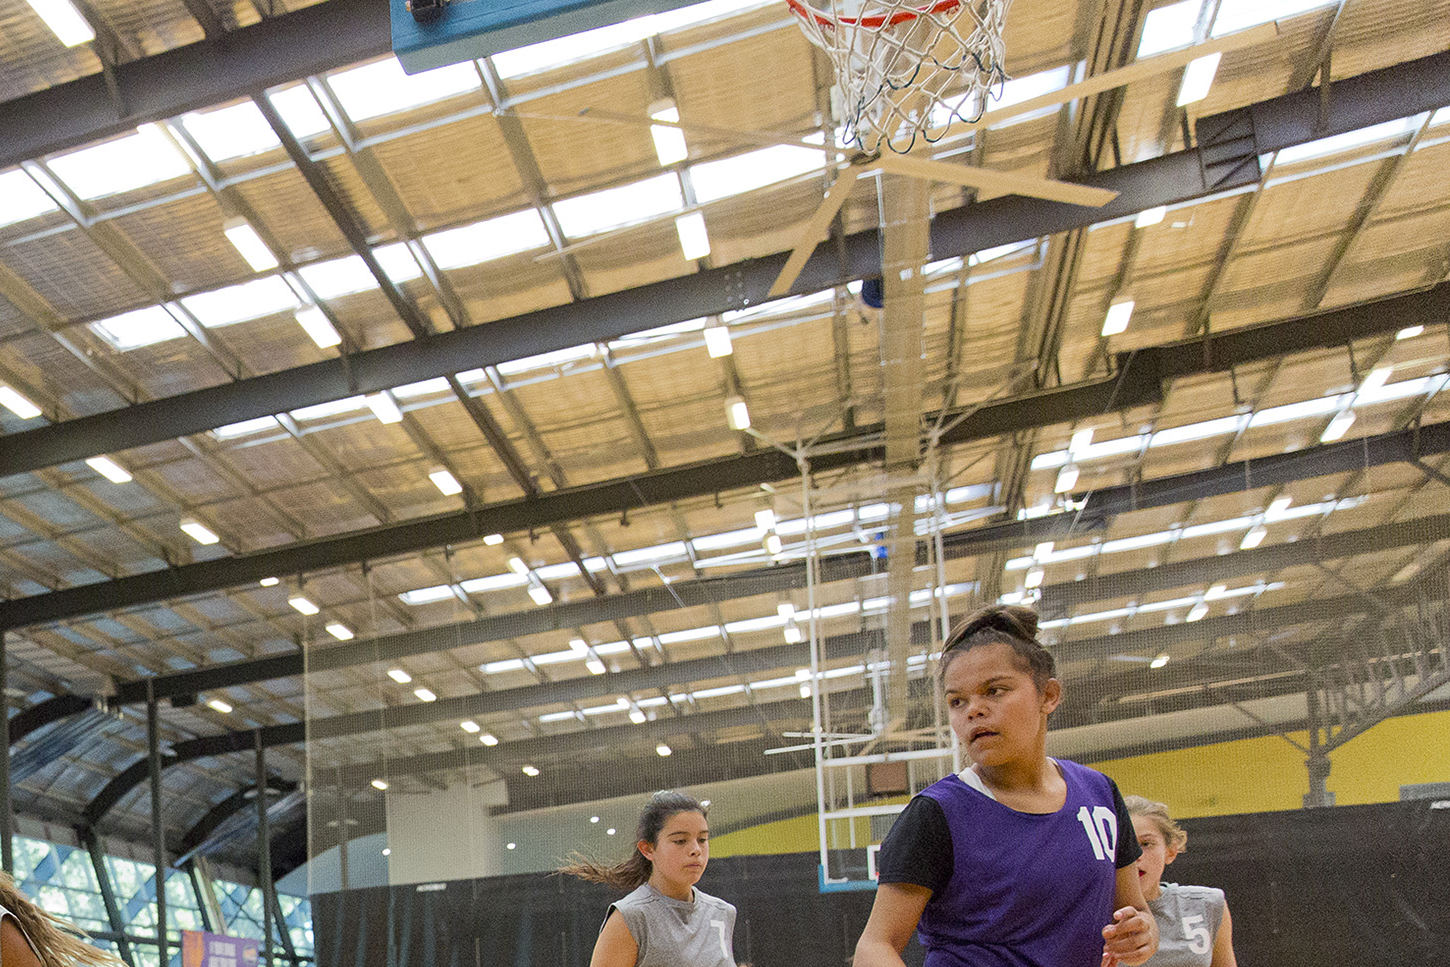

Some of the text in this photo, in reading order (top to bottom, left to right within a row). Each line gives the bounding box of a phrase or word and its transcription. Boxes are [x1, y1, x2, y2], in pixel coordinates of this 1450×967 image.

[1077, 806, 1117, 863] 10
[710, 919, 729, 958] 7
[1181, 915, 1211, 955] 5
